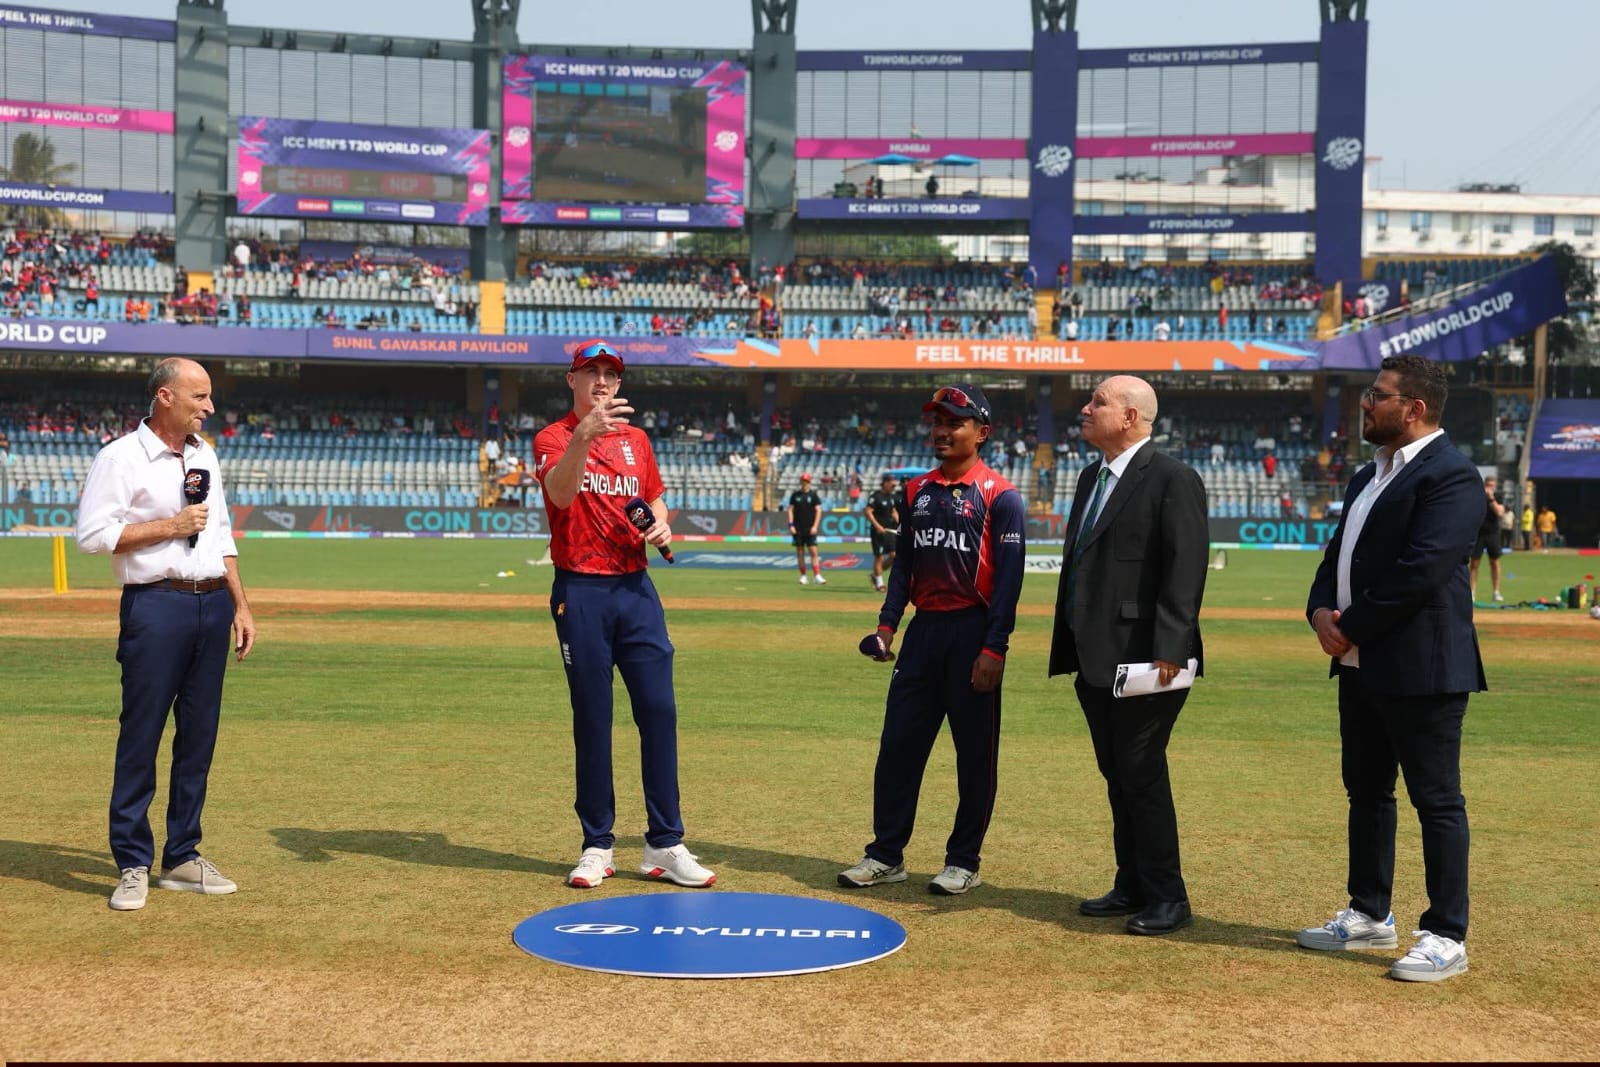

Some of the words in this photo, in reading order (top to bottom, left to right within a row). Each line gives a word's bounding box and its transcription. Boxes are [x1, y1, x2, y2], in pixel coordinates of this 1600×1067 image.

[29, 12, 52, 26] THE
[54, 15, 94, 29] THRILL
[1128, 52, 1147, 62] ICC
[1148, 51, 1179, 62] MEN'S
[1181, 50, 1199, 61] T20
[1201, 49, 1239, 60] WORLD
[1240, 48, 1263, 59] CUP
[545, 64, 566, 76] ICC
[568, 64, 606, 77] MEN'S
[608, 65, 630, 77] T20
[632, 66, 676, 78] WORLD
[679, 67, 704, 78] CUP
[31, 108, 51, 120] T20
[53, 110, 95, 122] WORLD
[96, 113, 119, 124] CUP
[283, 136, 305, 149] ICC
[307, 138, 347, 151] MEN'S
[348, 140, 372, 153] T20
[374, 142, 420, 156] WORLD
[421, 145, 449, 157] CUP
[889, 143, 931, 153] MUMBAI
[1151, 140, 1237, 151] #T20WORLDCUP
[849, 203, 867, 213] ICC
[868, 203, 900, 213] MEN'S
[901, 203, 919, 213] T20
[920, 204, 958, 214] WORLD
[959, 204, 981, 214] CUP
[1149, 219, 1235, 229] #T20WORLDCUP
[1379, 291, 1514, 359] #T20WORLDCUP
[60, 326, 107, 345] CUP
[333, 336, 376, 350] SUNIL
[380, 338, 457, 352] GAVASKAR
[461, 340, 529, 354] PAVILION
[916, 345, 966, 362] FEEL
[969, 345, 1009, 362] THE
[1012, 346, 1086, 364] THRILL
[580, 471, 639, 497] ENGLAND
[404, 510, 470, 532] COIN
[477, 510, 541, 533] TOSS
[914, 527, 971, 552] NEPAL
[1239, 521, 1306, 543] COIN
[652, 926, 871, 939] HYUNDAI
